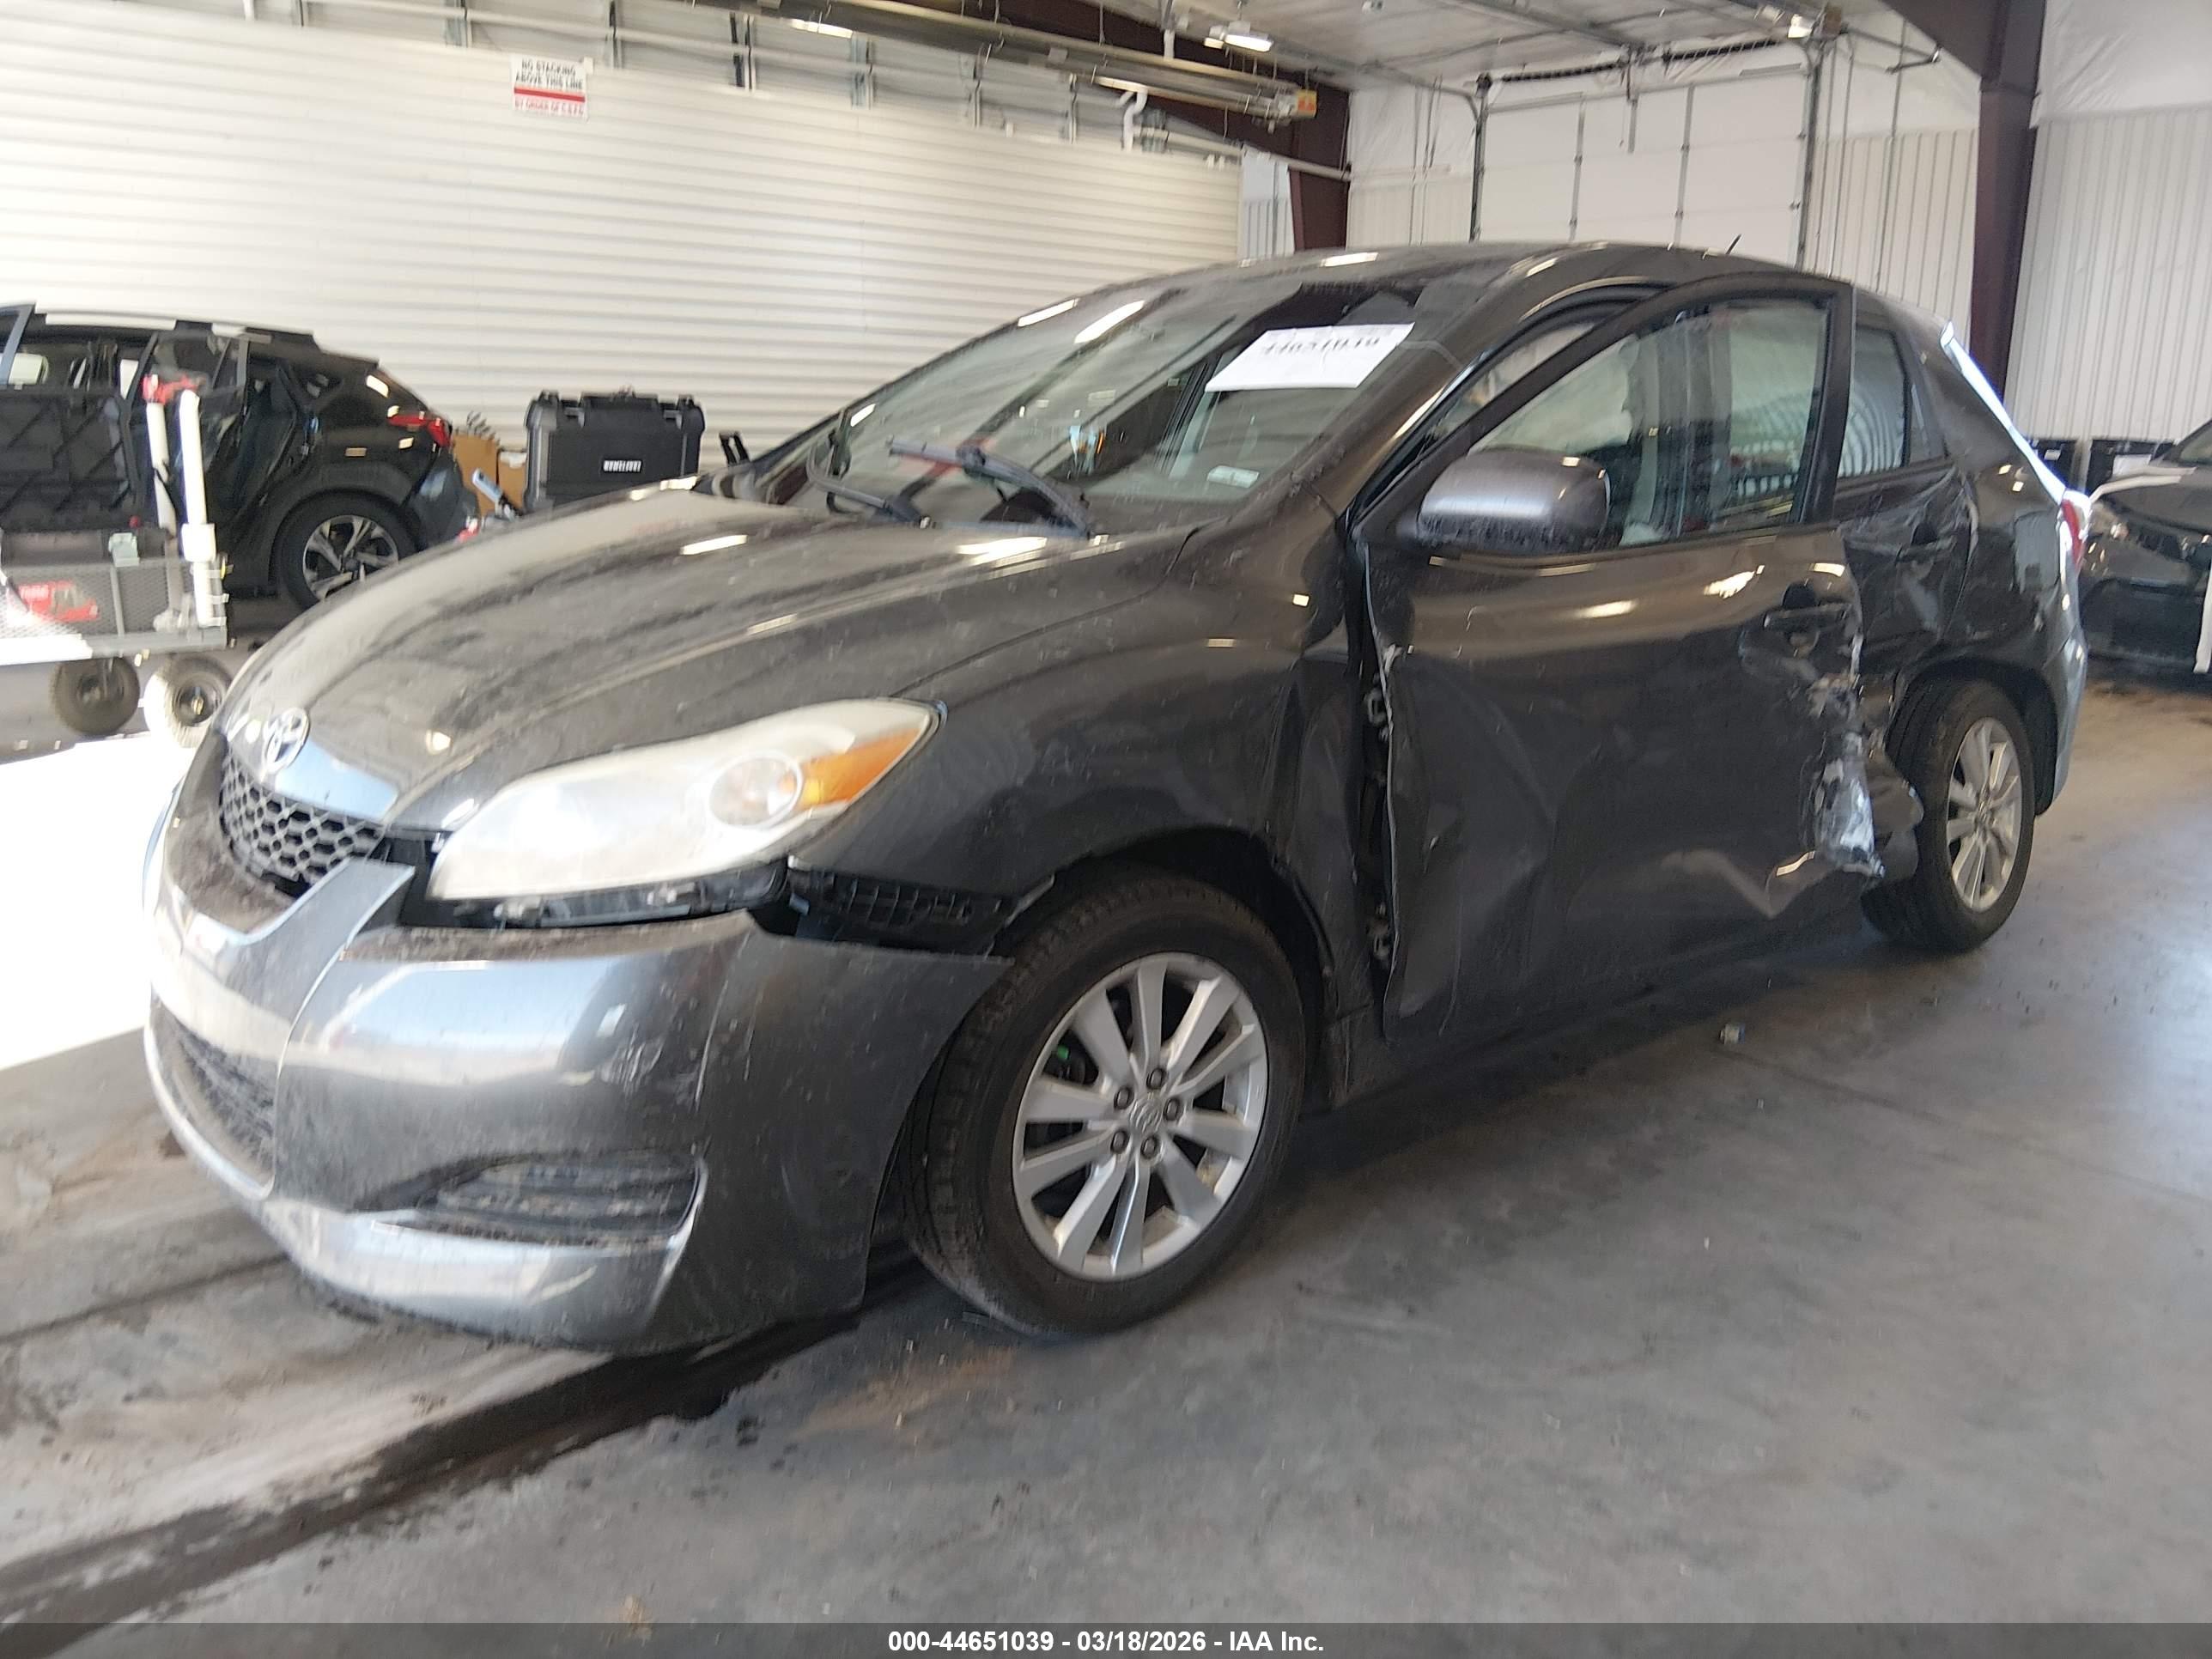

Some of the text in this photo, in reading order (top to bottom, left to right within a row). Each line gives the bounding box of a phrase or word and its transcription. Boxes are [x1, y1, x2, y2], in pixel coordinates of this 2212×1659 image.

[521, 58, 576, 76] NO STACKING
[515, 70, 583, 89] ABOVE THIS LINE
